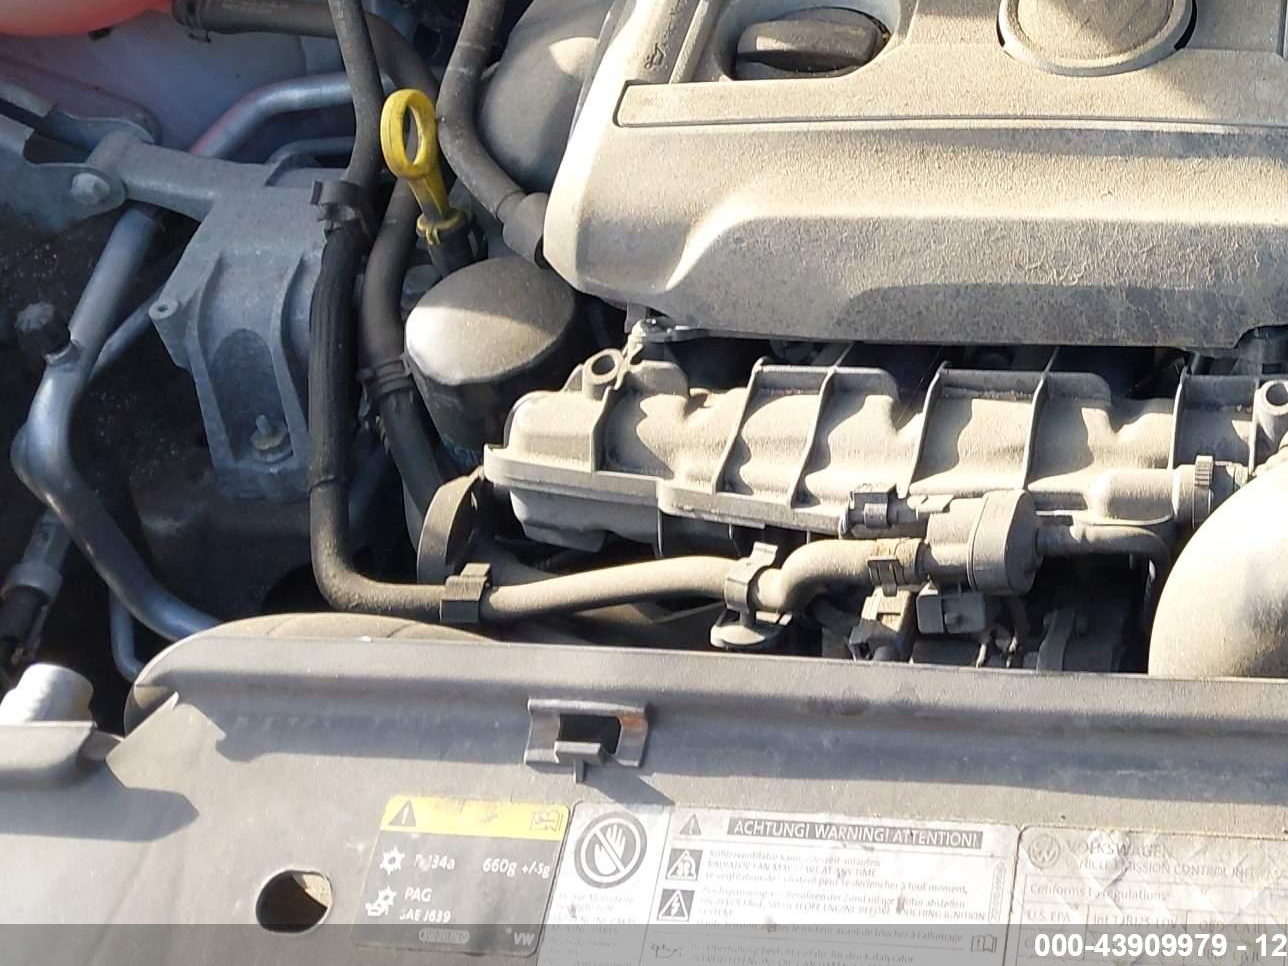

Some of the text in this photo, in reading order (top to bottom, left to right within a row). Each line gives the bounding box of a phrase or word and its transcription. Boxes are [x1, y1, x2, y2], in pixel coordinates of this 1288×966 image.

[733, 818, 979, 848] ACHTUNG! WARNING! ATTENTION!
[482, 857, 518, 877] 660g
[404, 886, 433, 902] PAG
[513, 932, 535, 946] VW
